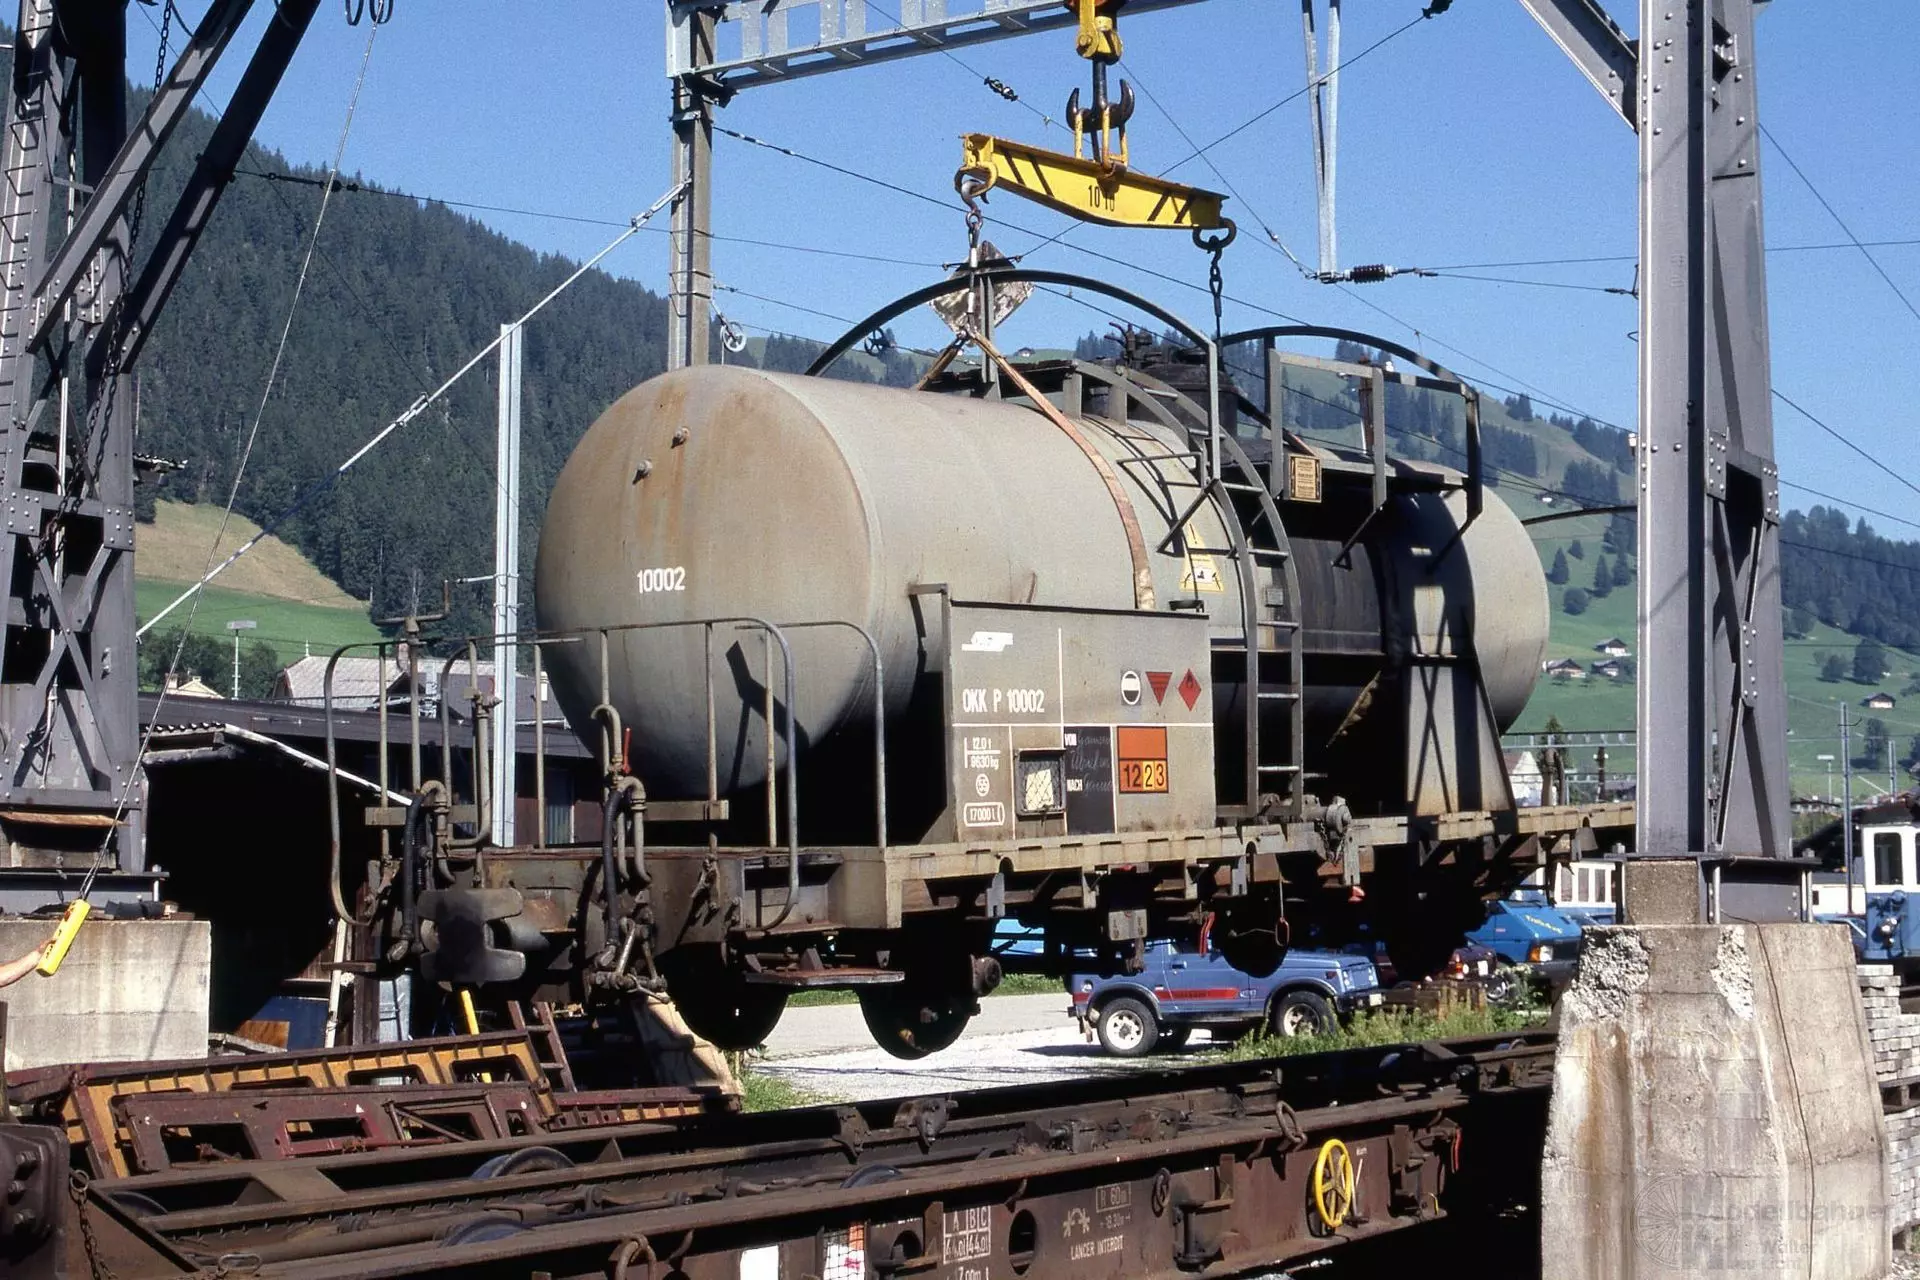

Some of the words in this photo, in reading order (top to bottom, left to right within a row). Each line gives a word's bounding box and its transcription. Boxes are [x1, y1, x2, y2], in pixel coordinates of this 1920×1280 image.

[1088, 184, 1100, 208] 10
[636, 566, 686, 594] 10002
[993, 688, 1002, 713] P
[1007, 688, 1045, 713] 10002
[1066, 778, 1083, 791] NACH
[1123, 763, 1165, 788] 1223
[953, 1210, 960, 1231] A
[969, 1208, 976, 1228] B
[980, 1206, 987, 1226] C
[1070, 1241, 1095, 1260] LANCER
